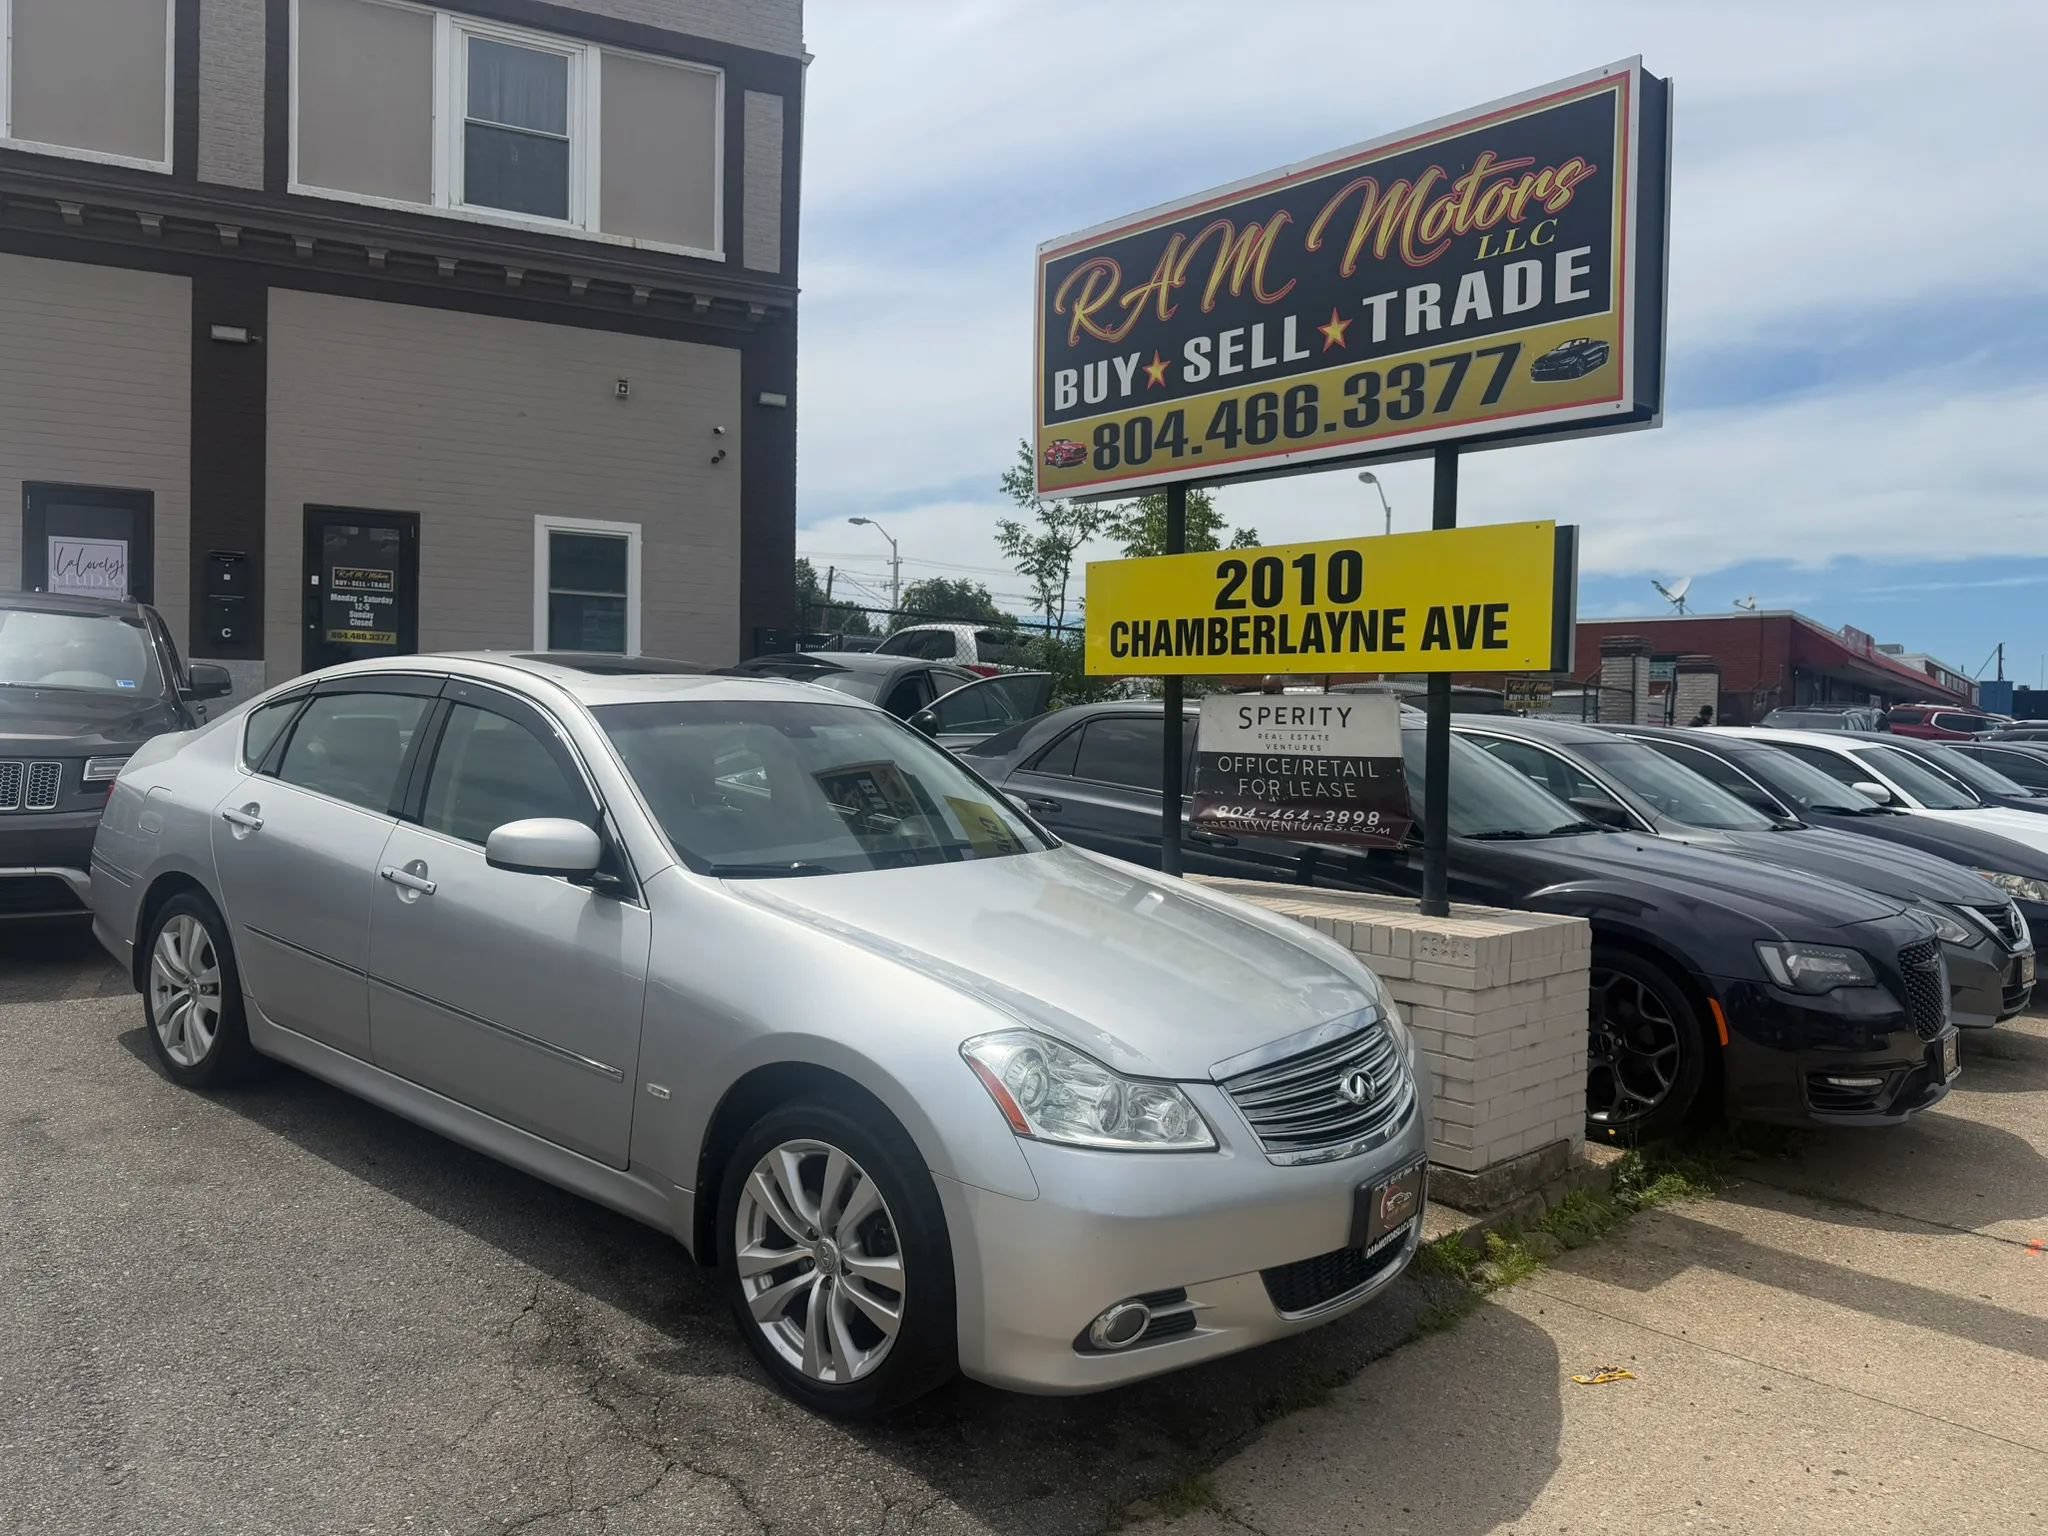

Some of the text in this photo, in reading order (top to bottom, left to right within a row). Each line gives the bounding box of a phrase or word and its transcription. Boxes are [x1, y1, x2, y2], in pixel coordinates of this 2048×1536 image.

[1054, 151, 1597, 346] RAM Motors
[1473, 218, 1558, 261] LLC
[1054, 245, 1591, 411] BUY SELL TRADE
[1093, 343, 1521, 471] 804.466.3377
[1215, 549, 1363, 610] 2010
[331, 593, 393, 605] Monday Saturday
[355, 602, 370, 610] 12-5
[349, 610, 374, 619] Sunday
[350, 618, 373, 627] Closed
[221, 627, 231, 638] C
[1110, 602, 1509, 658] CHAMBERLAYNE AVE
[1239, 707, 1352, 729] SPERITY
[1218, 756, 1379, 778] OFFICE/RETAIL
[1239, 778, 1357, 798] FOR LEASE
[1215, 805, 1380, 826] 804-464-3898
